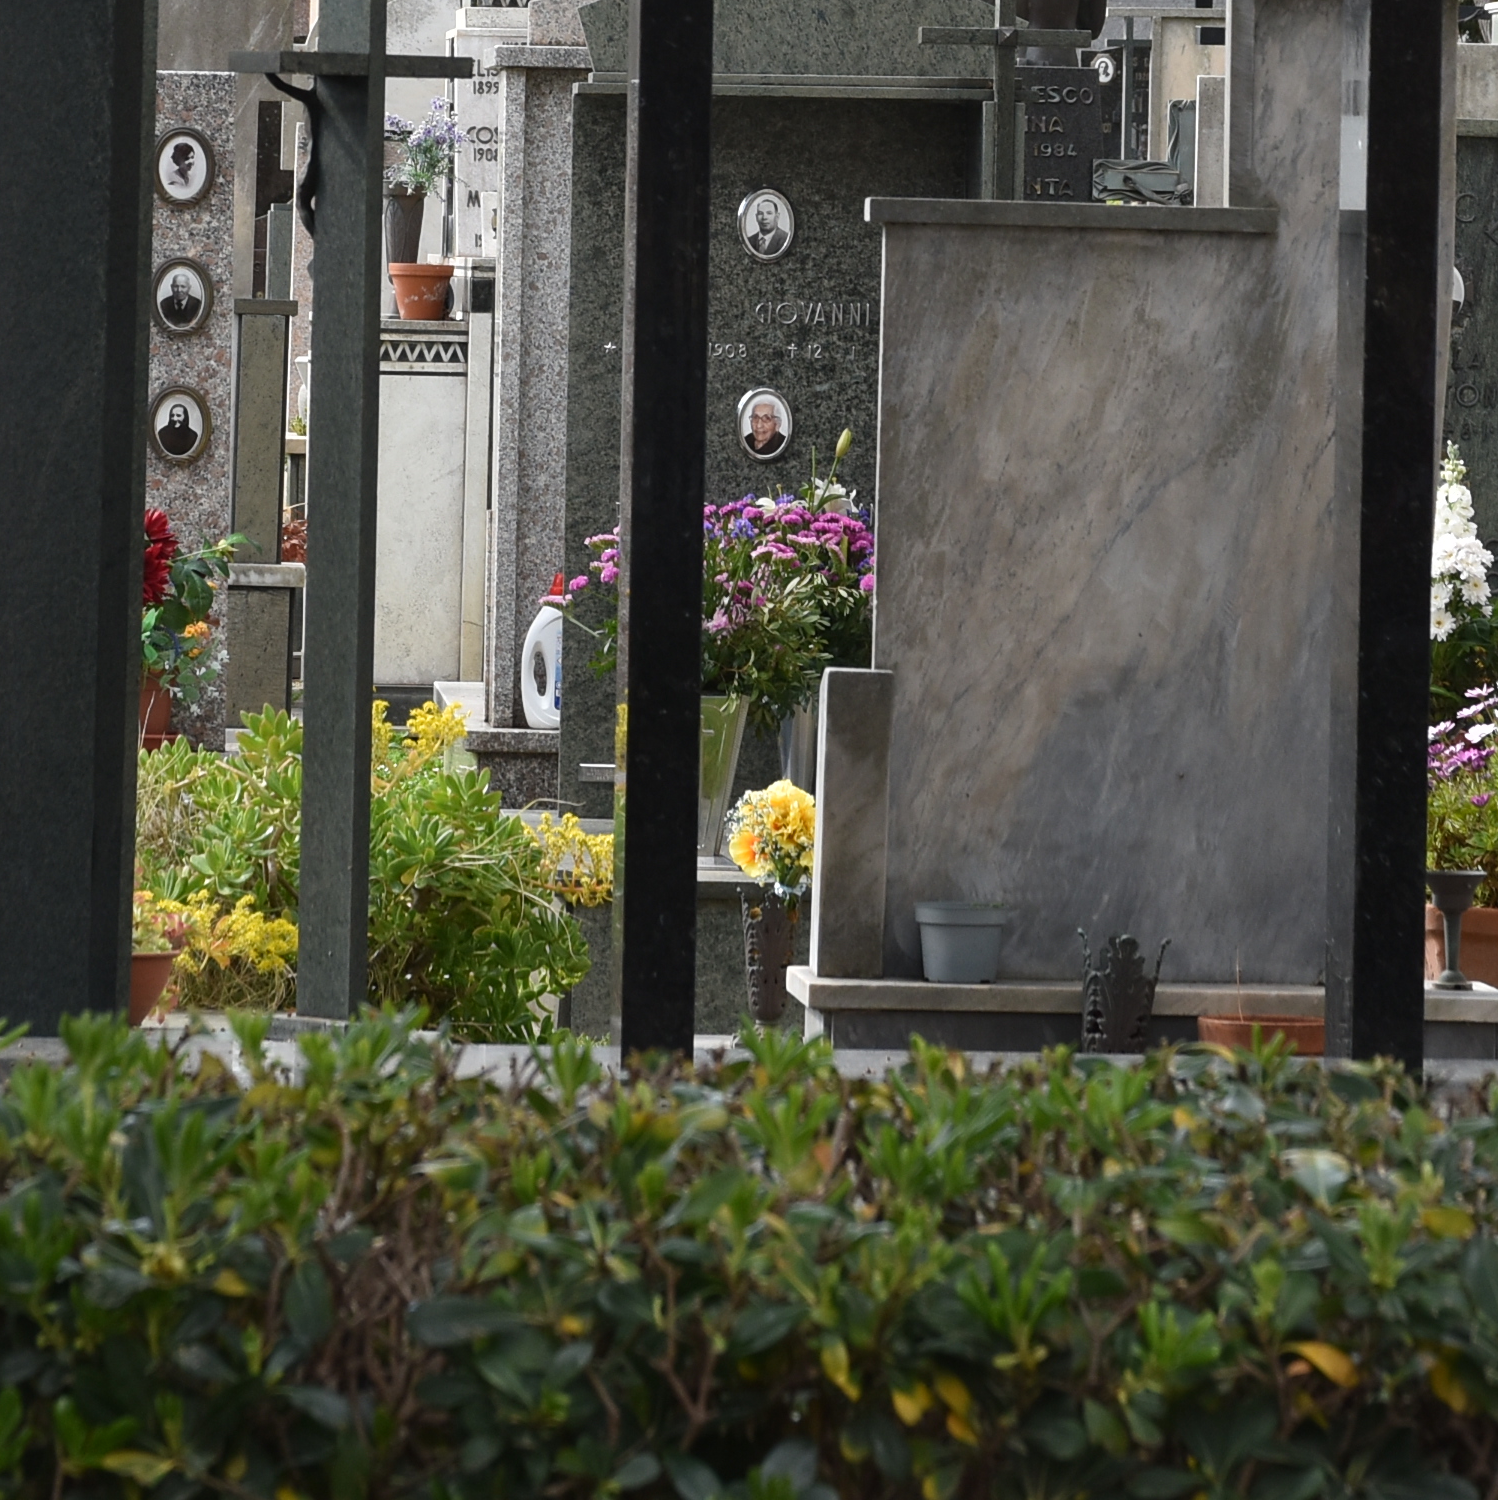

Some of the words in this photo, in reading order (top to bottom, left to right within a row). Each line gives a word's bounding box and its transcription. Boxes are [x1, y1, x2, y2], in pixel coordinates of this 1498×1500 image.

[1033, 143, 1078, 158] 1984
[755, 301, 871, 327] GIOVANNI
[707, 342, 748, 359] 1908
